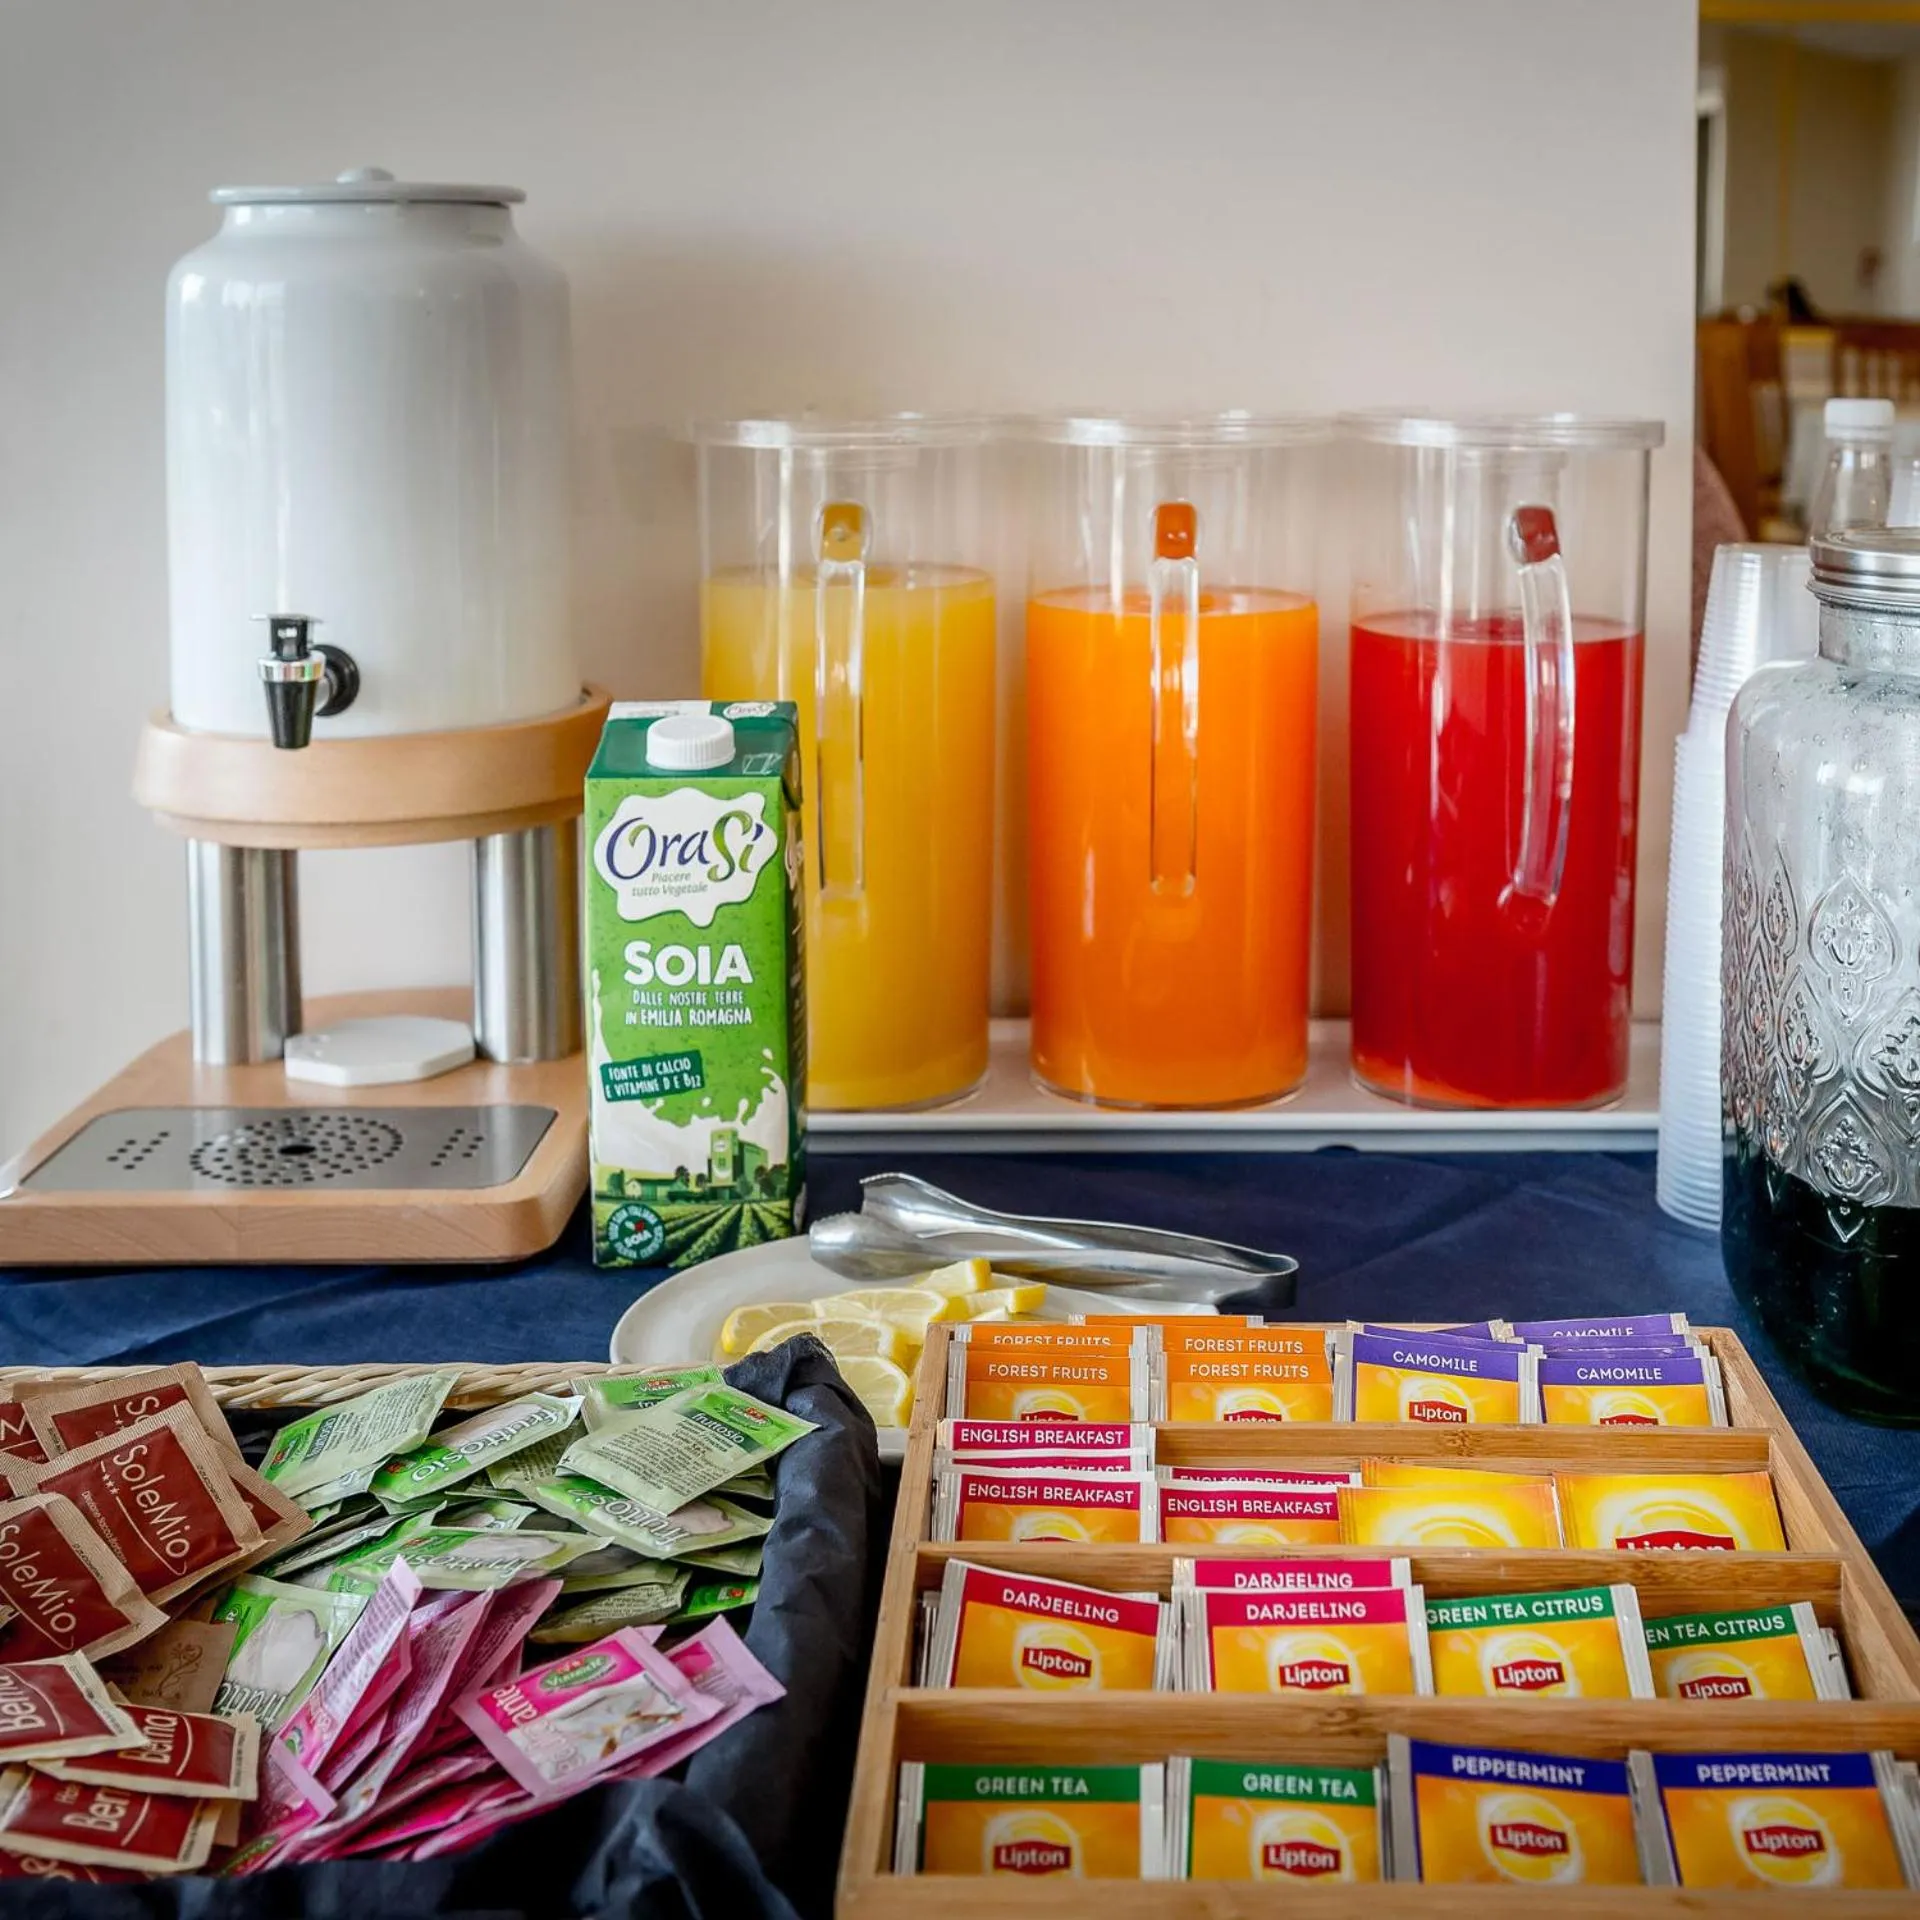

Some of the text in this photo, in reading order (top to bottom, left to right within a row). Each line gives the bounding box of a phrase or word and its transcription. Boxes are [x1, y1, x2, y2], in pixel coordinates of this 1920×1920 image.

[651, 871, 691, 883] Piacere
[632, 881, 709, 897] tutto Vegetale
[624, 940, 753, 986] SOIA
[632, 990, 663, 1005] DALLE
[669, 991, 707, 1006] NOSTRE
[640, 1009, 683, 1027] EMILIA
[689, 1007, 753, 1026] ROMAGNA
[608, 1057, 692, 1081] FONTE DI CALCIO
[605, 1085, 612, 1099] E
[614, 1078, 660, 1097] VITAMINE
[663, 1077, 670, 1091] D
[1185, 1338, 1304, 1354] FOREST FRUITS
[1190, 1364, 1309, 1378] FOREST FRUITS
[1392, 1351, 1478, 1372] CAMOMILE
[989, 1364, 1108, 1381] FOREST FRUITS
[1577, 1367, 1663, 1380] CAMOMILE
[1413, 1404, 1463, 1422] Lipton
[692, 1412, 746, 1445] fruttosio
[961, 1428, 1124, 1445] ENGLISH BREAKFAST
[411, 1408, 559, 1482] fruttosio
[113, 1444, 190, 1558] SoleMio
[968, 1483, 1134, 1504] ENGLISH BREAKFAST
[1168, 1498, 1333, 1515] ENGLISH BREAKFAST
[0, 1525, 76, 1633] SoleMio
[1234, 1572, 1353, 1589] DARJEELING
[1002, 1587, 1120, 1624] DARJEELING
[1246, 1602, 1367, 1620] DARJEELING
[1426, 1595, 1604, 1625] GREEN TEA CITRUS
[1673, 1622, 1711, 1639] TEA
[1715, 1615, 1786, 1636] CITRUS
[1027, 1649, 1087, 1676] Lipton
[1283, 1665, 1345, 1686] Lipton
[1498, 1666, 1559, 1687] Lipton
[1685, 1681, 1746, 1699] Lipton
[1452, 1755, 1585, 1786] PEPPERMINT
[1697, 1764, 1830, 1783] PEPPERMINT
[975, 1777, 1089, 1795] GREEN TEA
[1243, 1773, 1358, 1798] GREEN TEA
[1496, 1828, 1562, 1851] Lipton
[1750, 1832, 1818, 1853] Lipton
[1000, 1846, 1065, 1868] Lipton
[1268, 1847, 1335, 1870] Lipton
